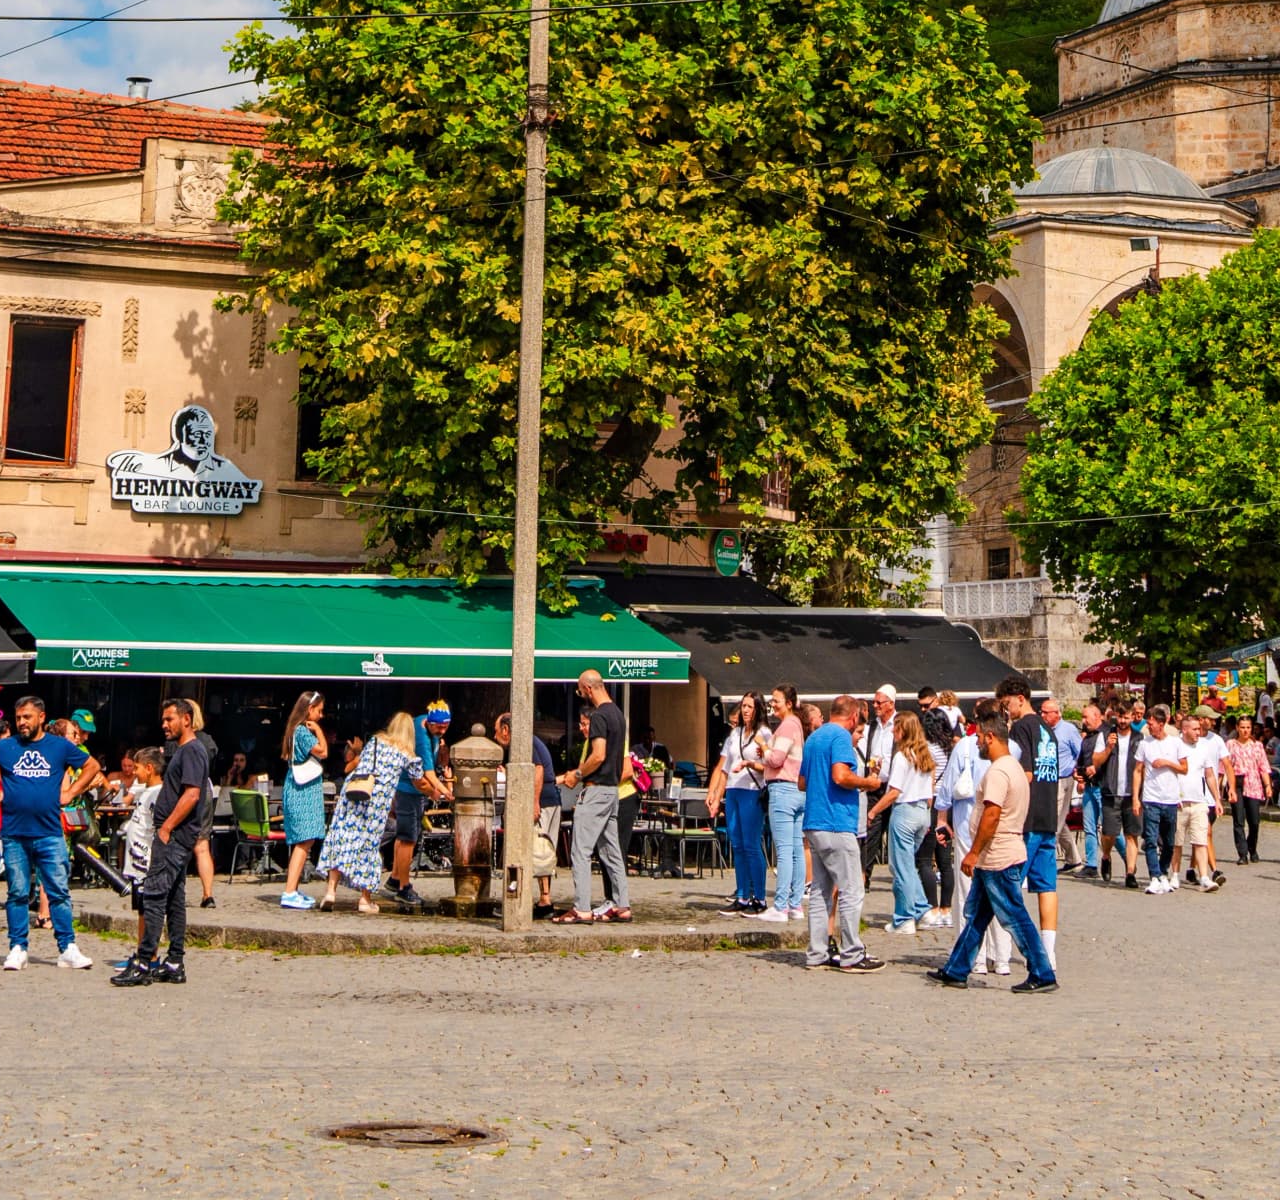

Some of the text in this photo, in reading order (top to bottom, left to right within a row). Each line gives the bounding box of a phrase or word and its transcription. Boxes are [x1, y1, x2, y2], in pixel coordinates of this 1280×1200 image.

[110, 452, 144, 477] The
[115, 478, 258, 500] HEMINGWAY
[144, 501, 231, 512] BAR LOUNGE
[87, 649, 130, 658] UDINESE
[621, 659, 659, 668] UDINESE
